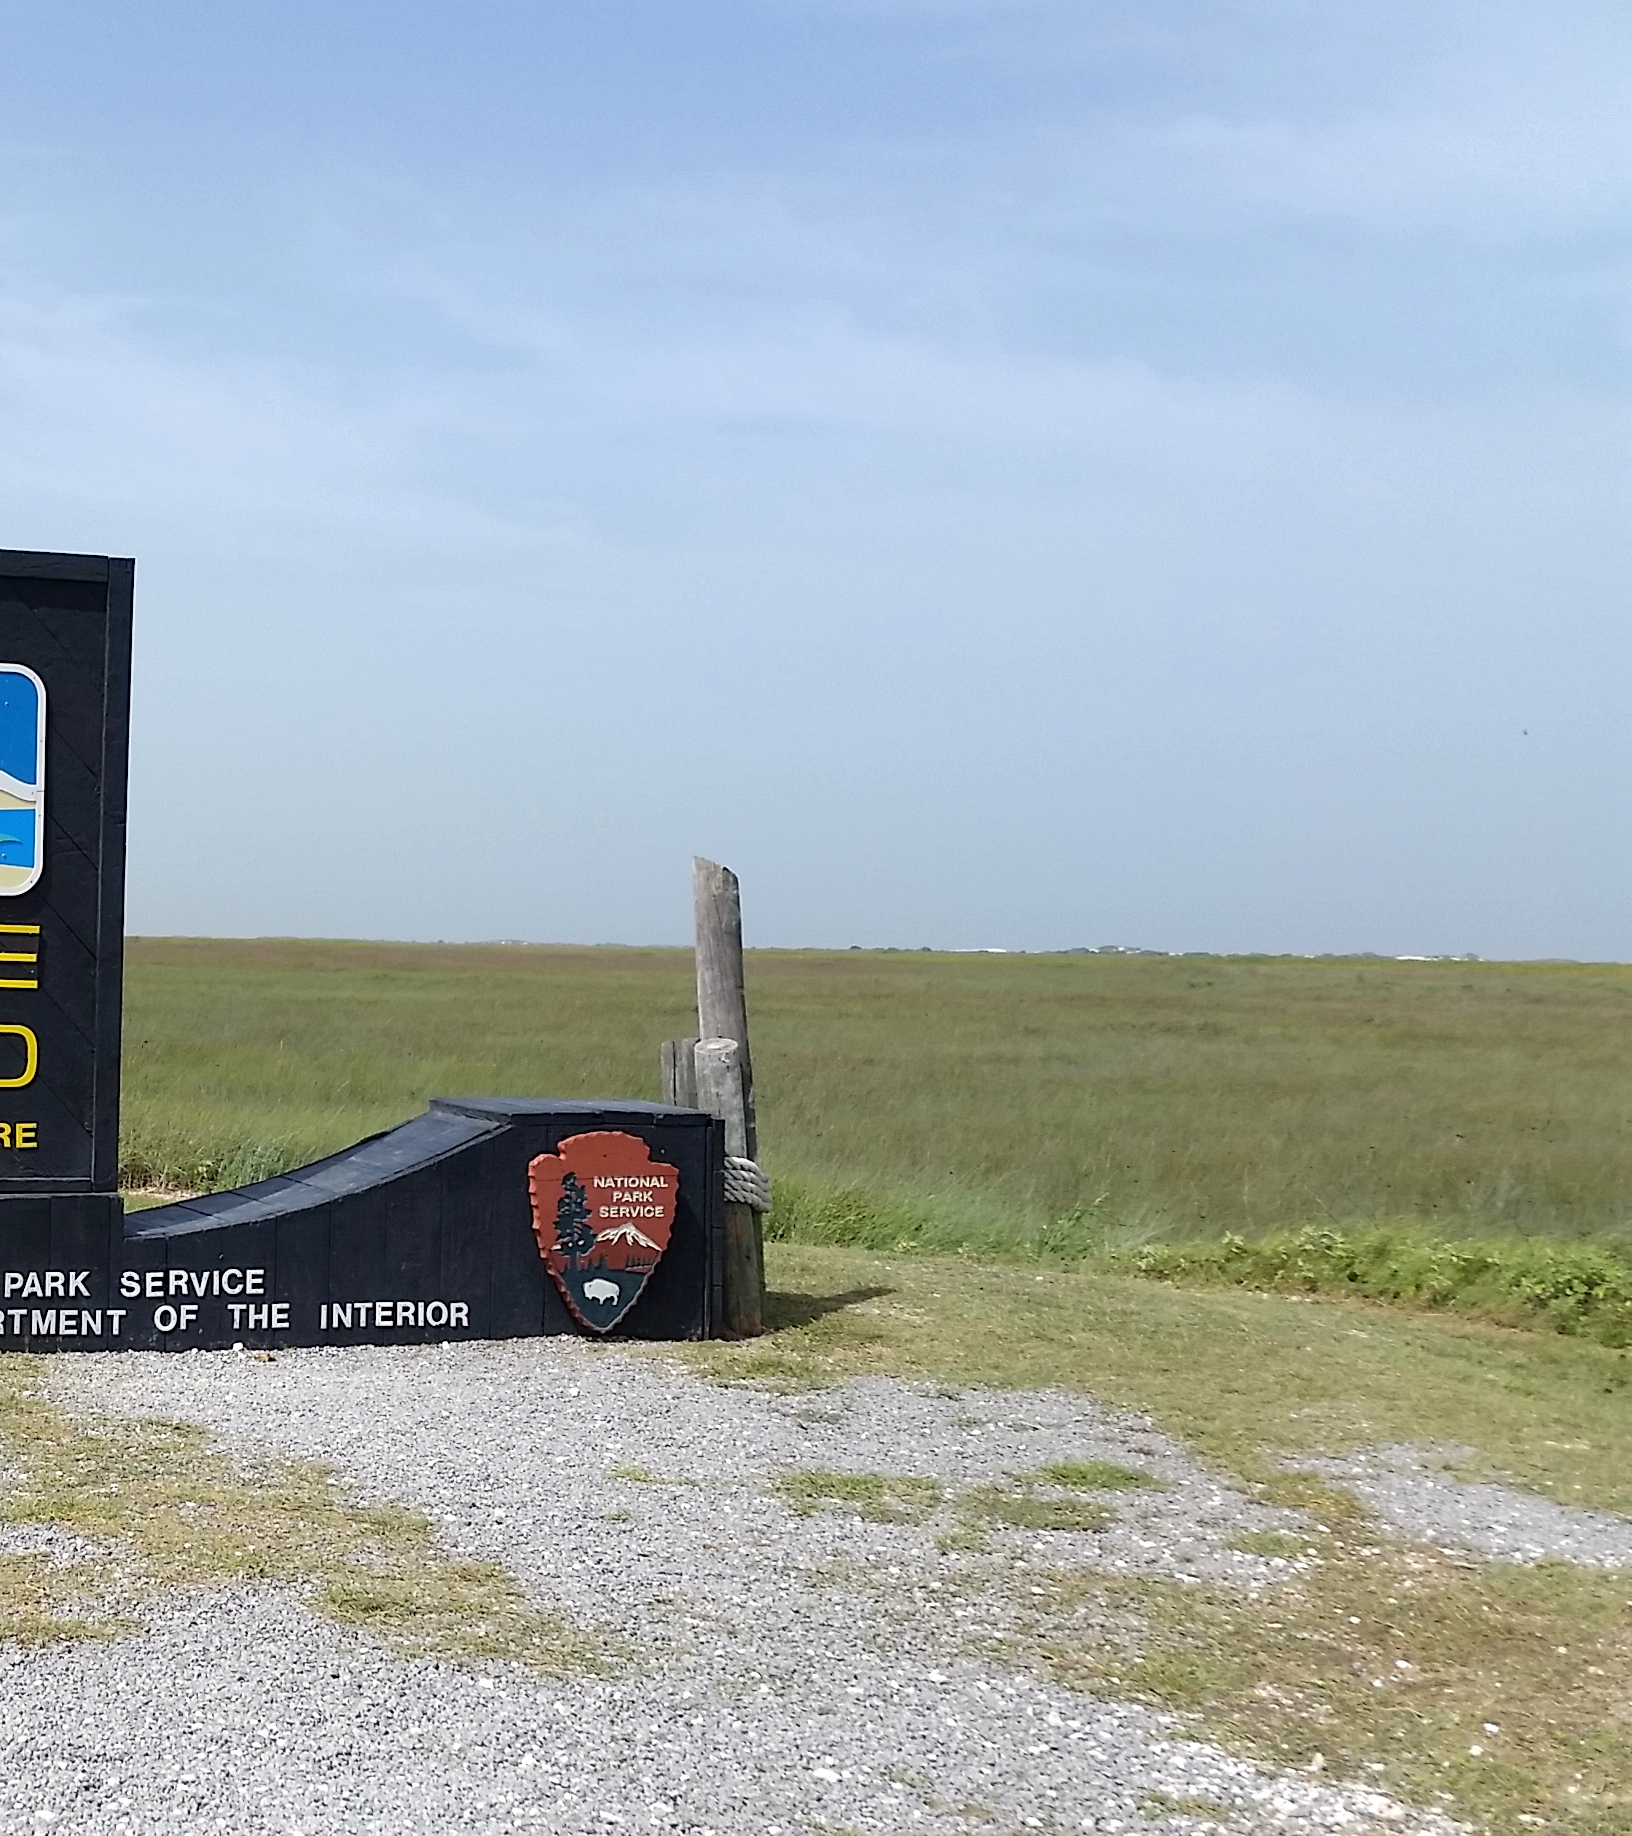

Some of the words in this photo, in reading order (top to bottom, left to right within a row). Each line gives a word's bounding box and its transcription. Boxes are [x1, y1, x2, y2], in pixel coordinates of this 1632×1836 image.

[593, 1175, 669, 1188] NATIONAL
[612, 1190, 654, 1203] PARK
[598, 1205, 665, 1218] SERVICE
[4, 1271, 91, 1298] PARK
[120, 1269, 265, 1298] SERVICE
[153, 1304, 199, 1332] OF
[227, 1303, 291, 1330] THE
[320, 1300, 469, 1330] INTERIOR
